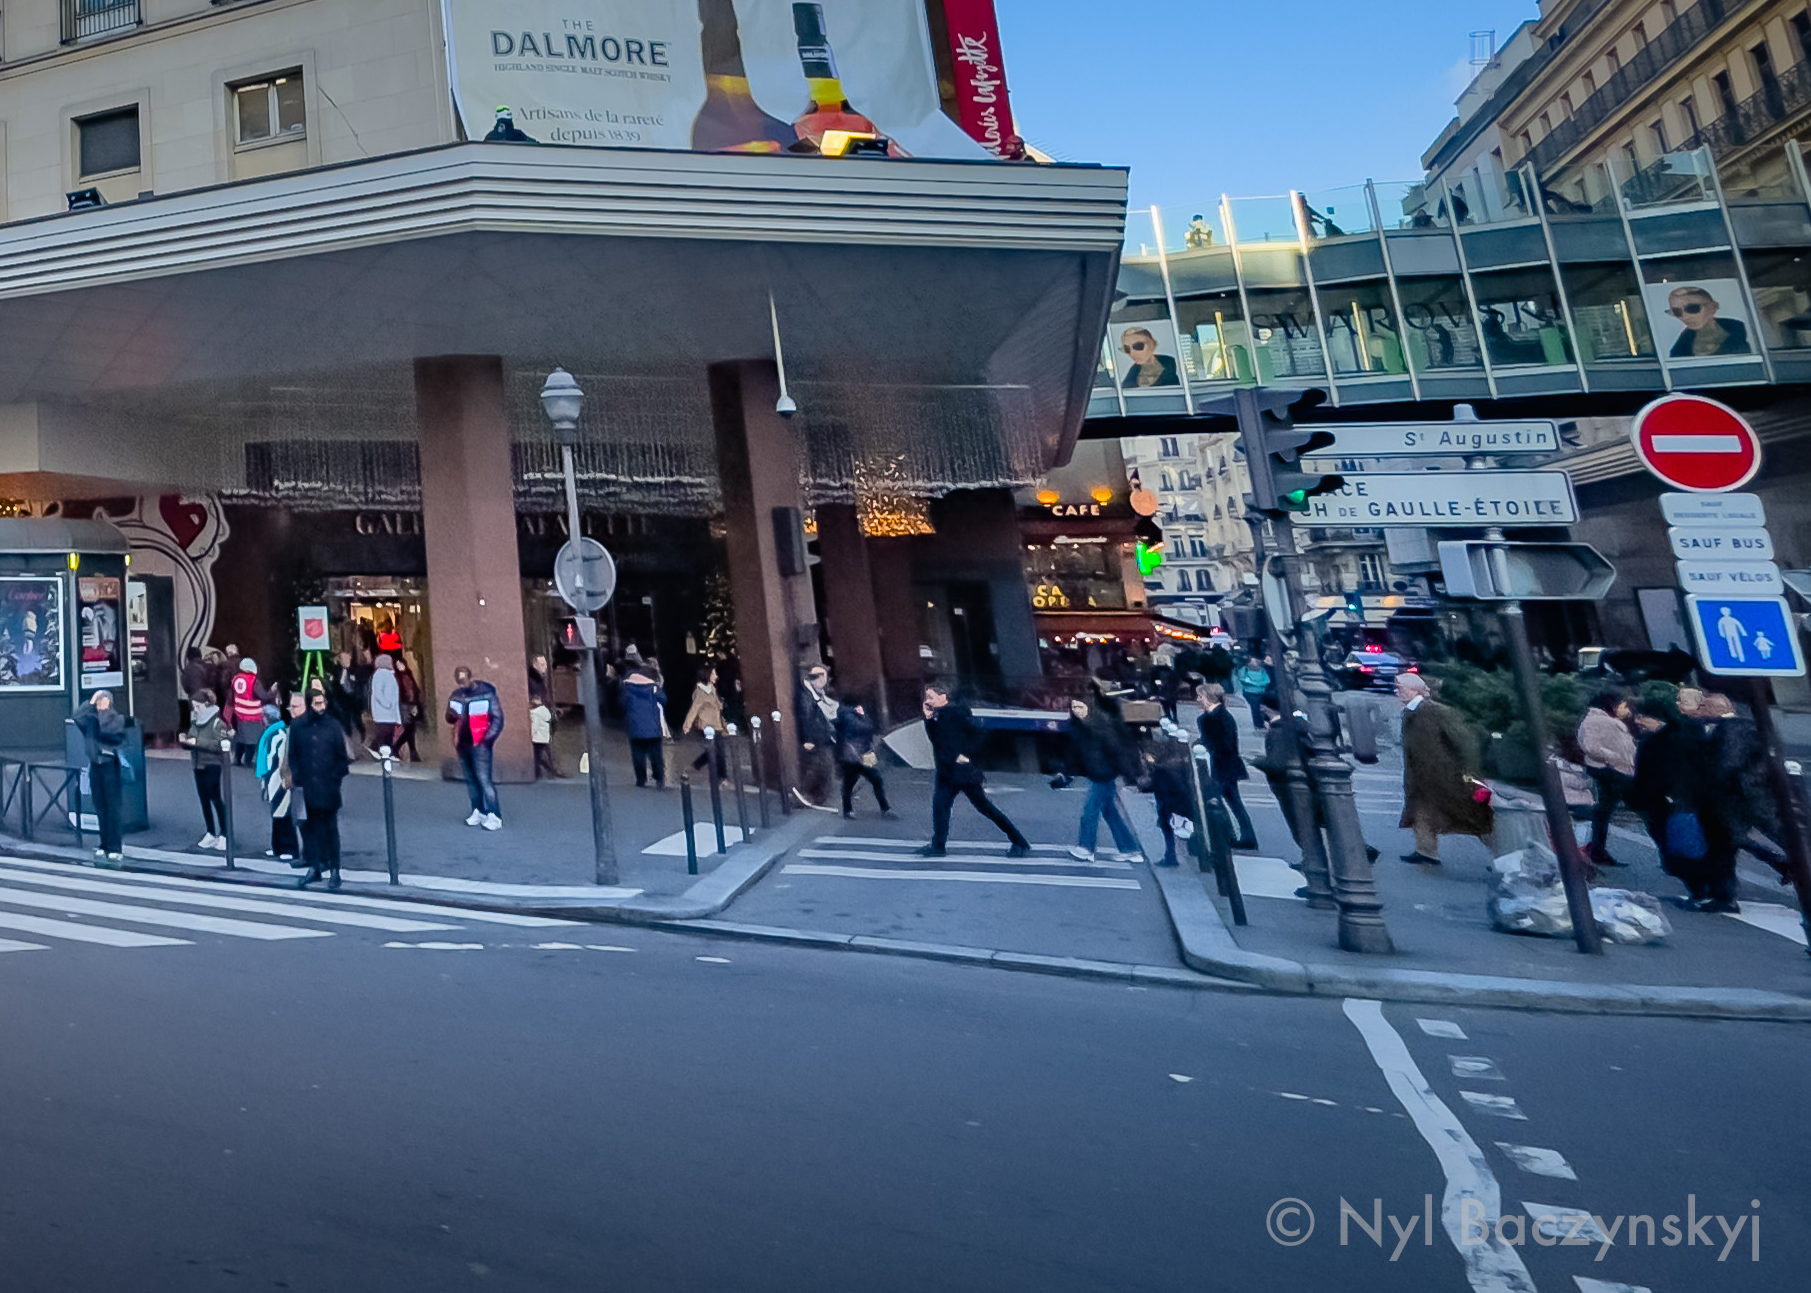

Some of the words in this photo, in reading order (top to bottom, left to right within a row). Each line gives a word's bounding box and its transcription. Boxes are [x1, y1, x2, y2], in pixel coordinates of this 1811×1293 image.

[561, 19, 593, 31] THE
[490, 30, 670, 68] DALMORE
[494, 63, 544, 72] HIGHLAND
[545, 64, 577, 73] SINGLE
[580, 66, 602, 75] MALT
[604, 68, 637, 79] SCOTCH
[639, 72, 672, 84] WHISKY
[956, 30, 1001, 103] Lafayette
[517, 107, 580, 121] Artisans
[584, 108, 603, 122] de
[606, 110, 619, 123] la
[623, 114, 665, 126] rareté
[550, 127, 606, 143] depuis
[608, 129, 641, 142] 1839
[1404, 431, 1425, 446] St
[1440, 430, 1547, 449] Augustin
[1052, 505, 1101, 516] CAFE
[1368, 497, 1564, 517] GAULLE-ÉTOILE
[1679, 538, 1722, 549] SAUF
[1732, 538, 1765, 549] BUS
[1689, 572, 1723, 582] SAUF
[1728, 571, 1773, 582] VÉLOS
